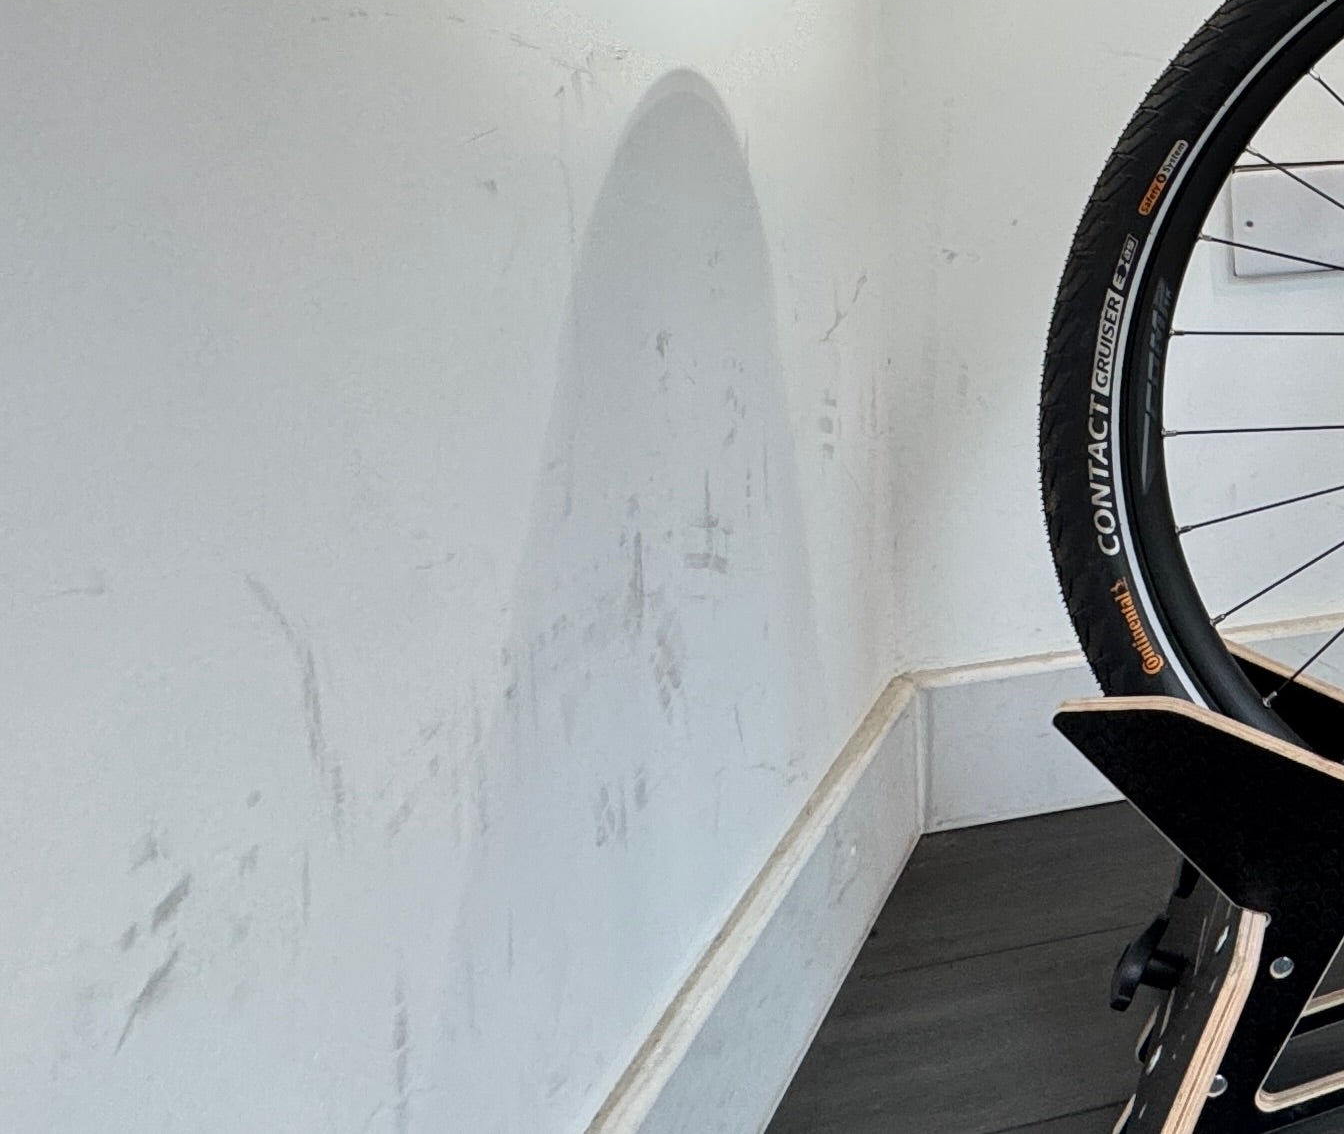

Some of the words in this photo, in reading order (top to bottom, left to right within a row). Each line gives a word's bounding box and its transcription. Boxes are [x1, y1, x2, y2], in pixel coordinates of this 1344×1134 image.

[1140, 183, 1162, 214] Safety
[1163, 141, 1186, 174] System
[1095, 295, 1122, 388] CRUISER
[1087, 392, 1120, 557] CONTACT
